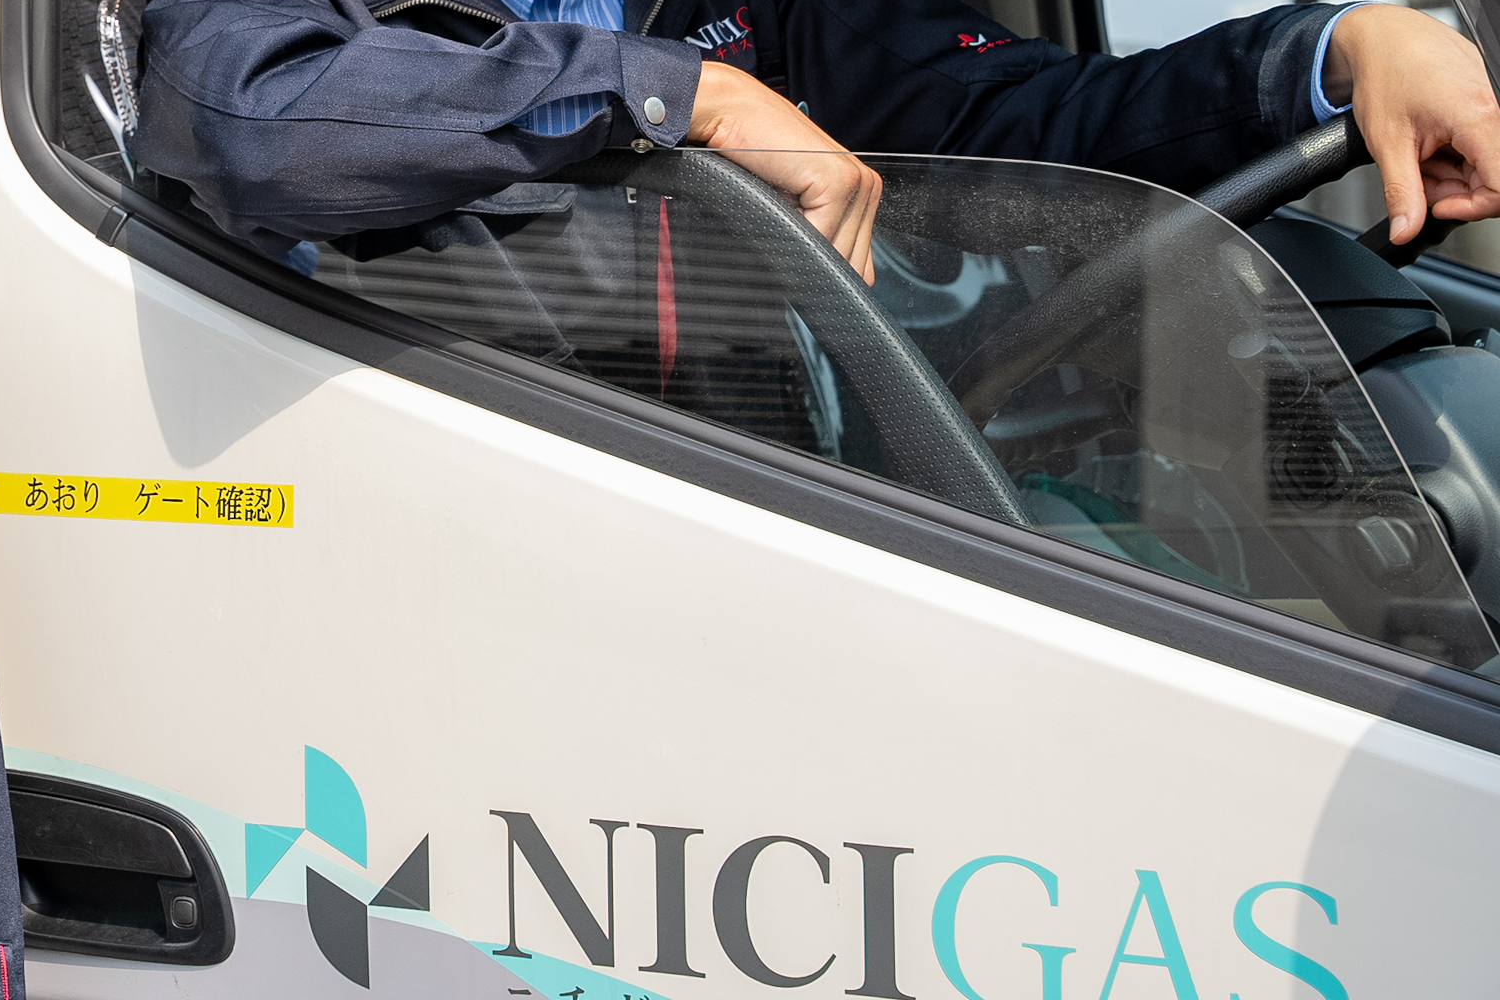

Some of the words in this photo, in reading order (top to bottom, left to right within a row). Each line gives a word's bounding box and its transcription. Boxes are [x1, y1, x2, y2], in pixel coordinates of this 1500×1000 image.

[25, 477, 100, 513] あおり
[134, 483, 287, 524] ゲート確認）
[489, 809, 1351, 1000] NICIGAS
